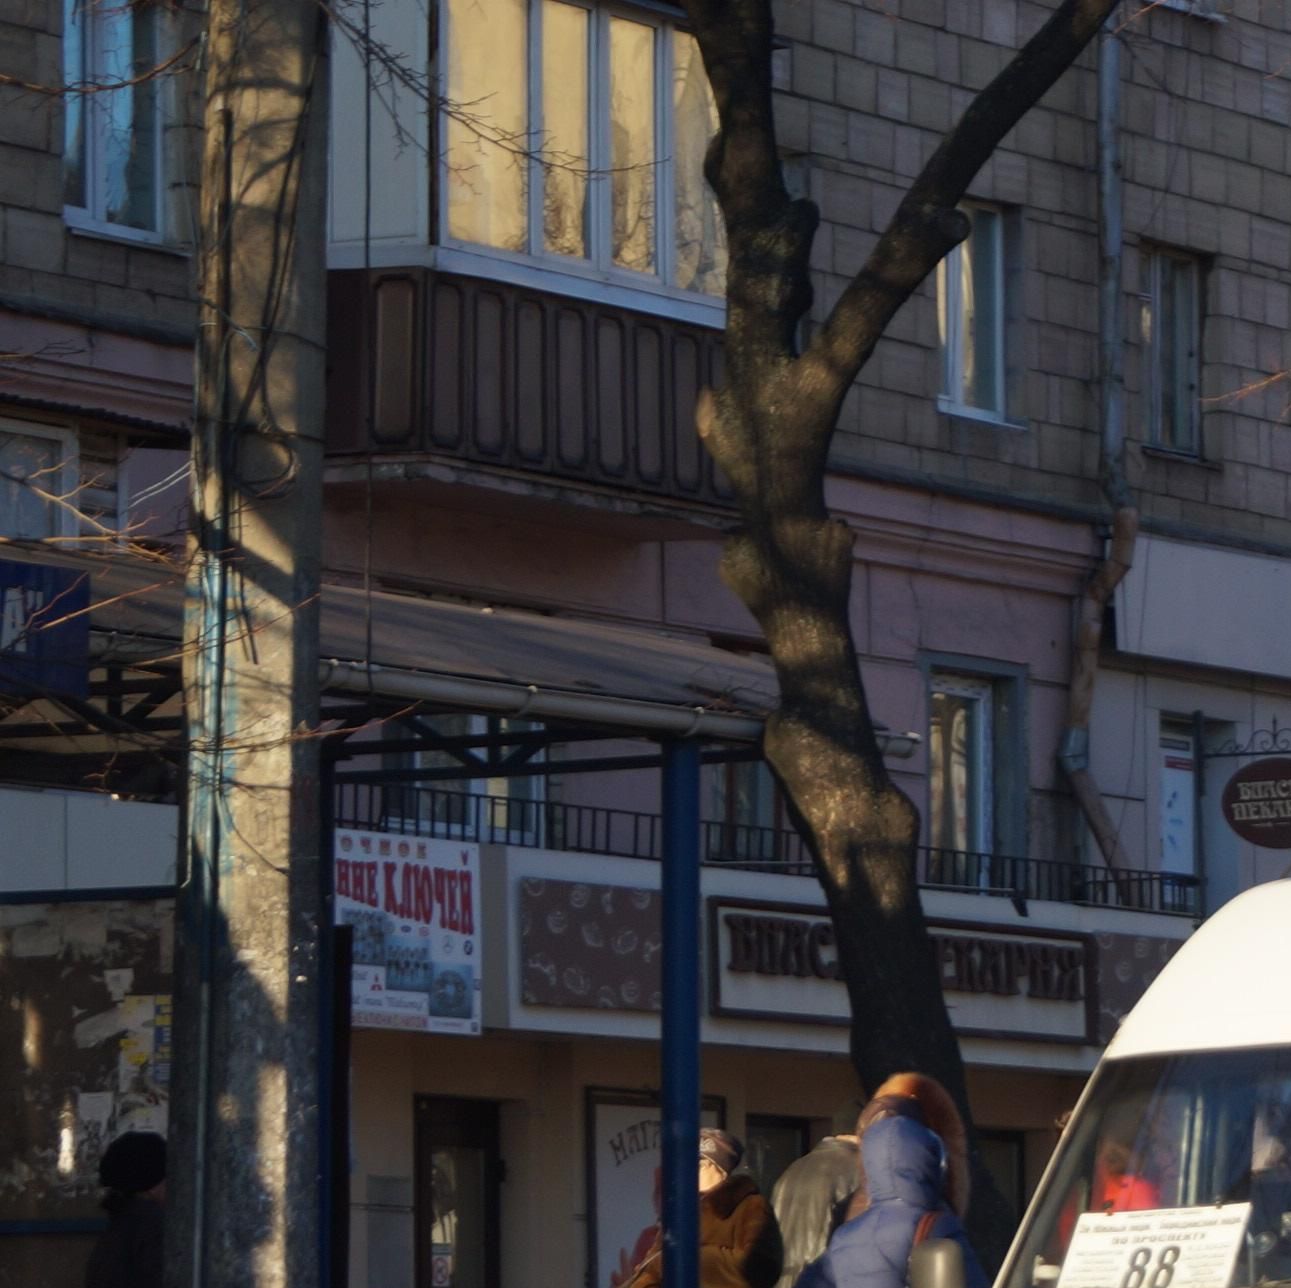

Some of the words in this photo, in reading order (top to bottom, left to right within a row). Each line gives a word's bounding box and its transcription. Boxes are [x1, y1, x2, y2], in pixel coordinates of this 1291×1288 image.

[383, 851, 474, 935] КЛЮЧЕЙ
[724, 913, 838, 979] ВЛАС
[937, 935, 1083, 1000] ЕКАРНЯ
